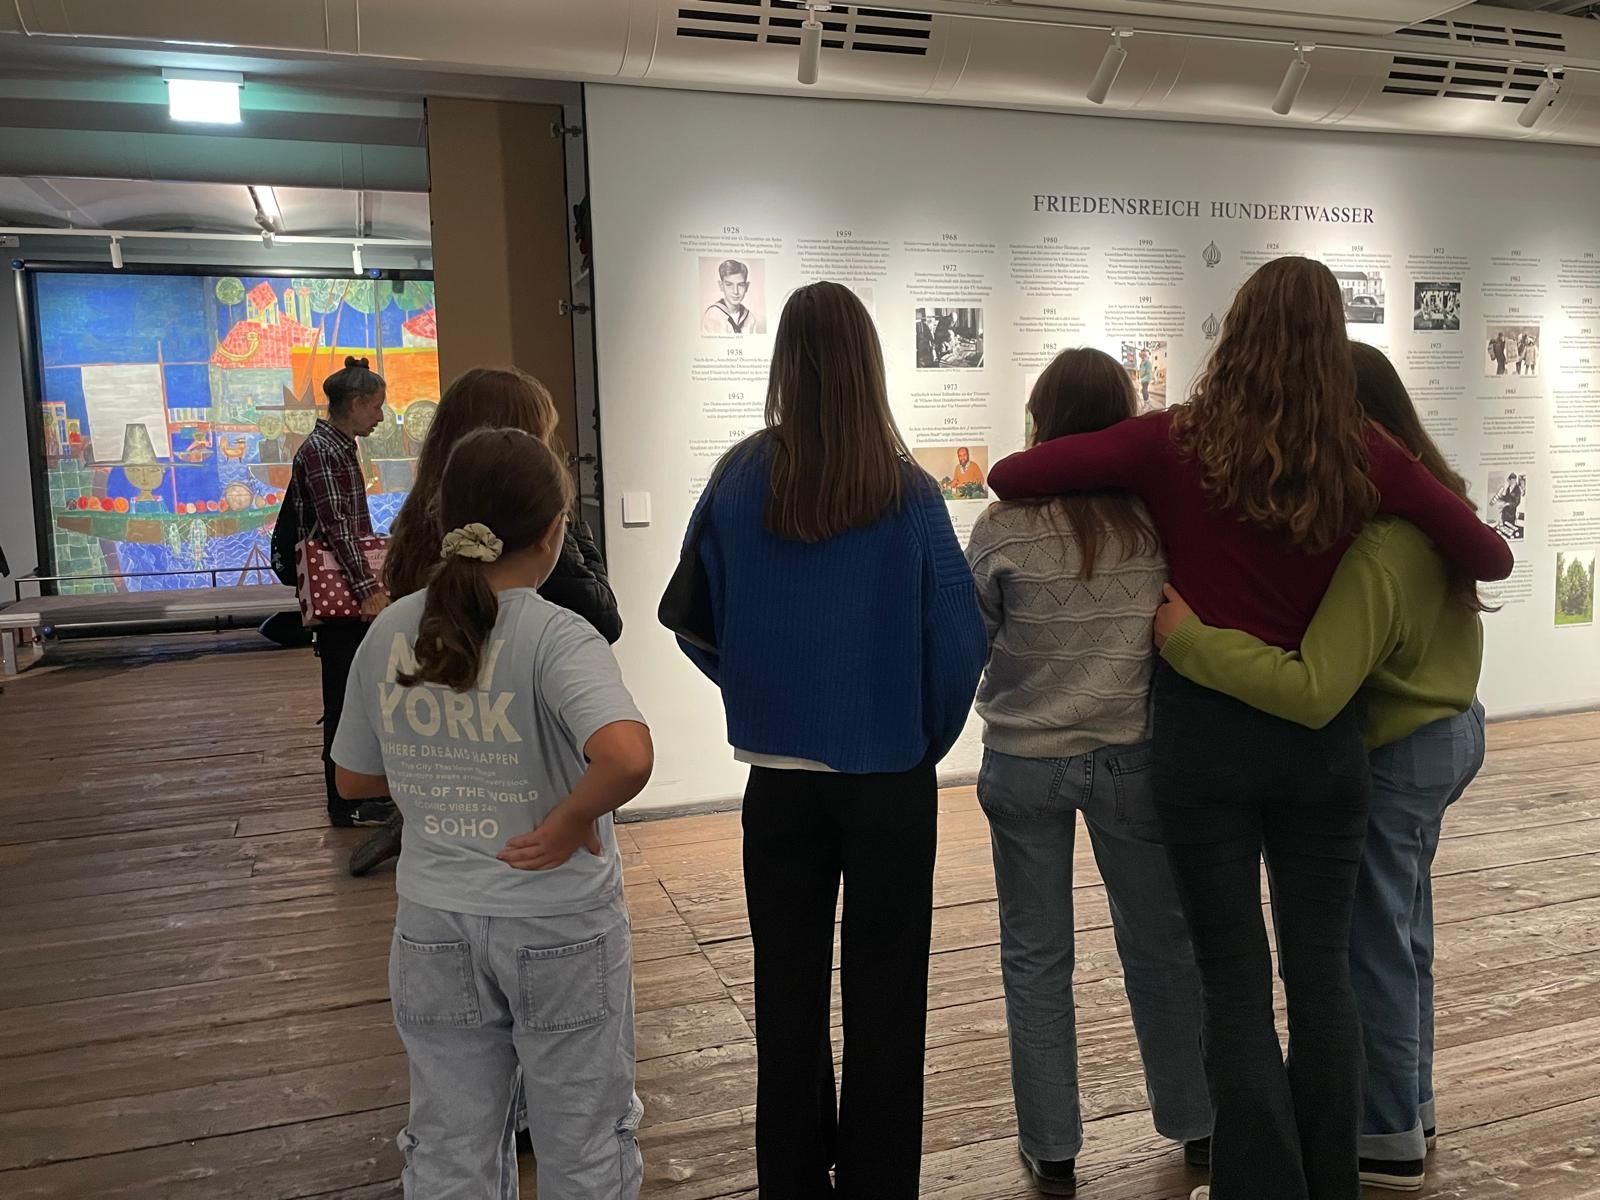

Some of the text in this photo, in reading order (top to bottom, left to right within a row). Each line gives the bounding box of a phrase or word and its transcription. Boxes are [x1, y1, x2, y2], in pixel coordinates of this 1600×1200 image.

[1032, 194, 1374, 224] FRIEDENSREICH HUNDERTWASSER
[722, 226, 740, 234] 1928
[727, 348, 743, 356] 1938
[943, 383, 958, 391] 1973
[728, 392, 744, 400] 1943
[376, 682, 523, 742] YORK
[421, 745, 470, 760] DREAMS
[473, 751, 519, 765] HAPPEN
[415, 763, 432, 771] City
[431, 786, 451, 797] OF
[455, 786, 485, 798] THE
[488, 790, 539, 804] WORLD
[448, 803, 479, 812] VIBES
[424, 815, 499, 840] SOHO
